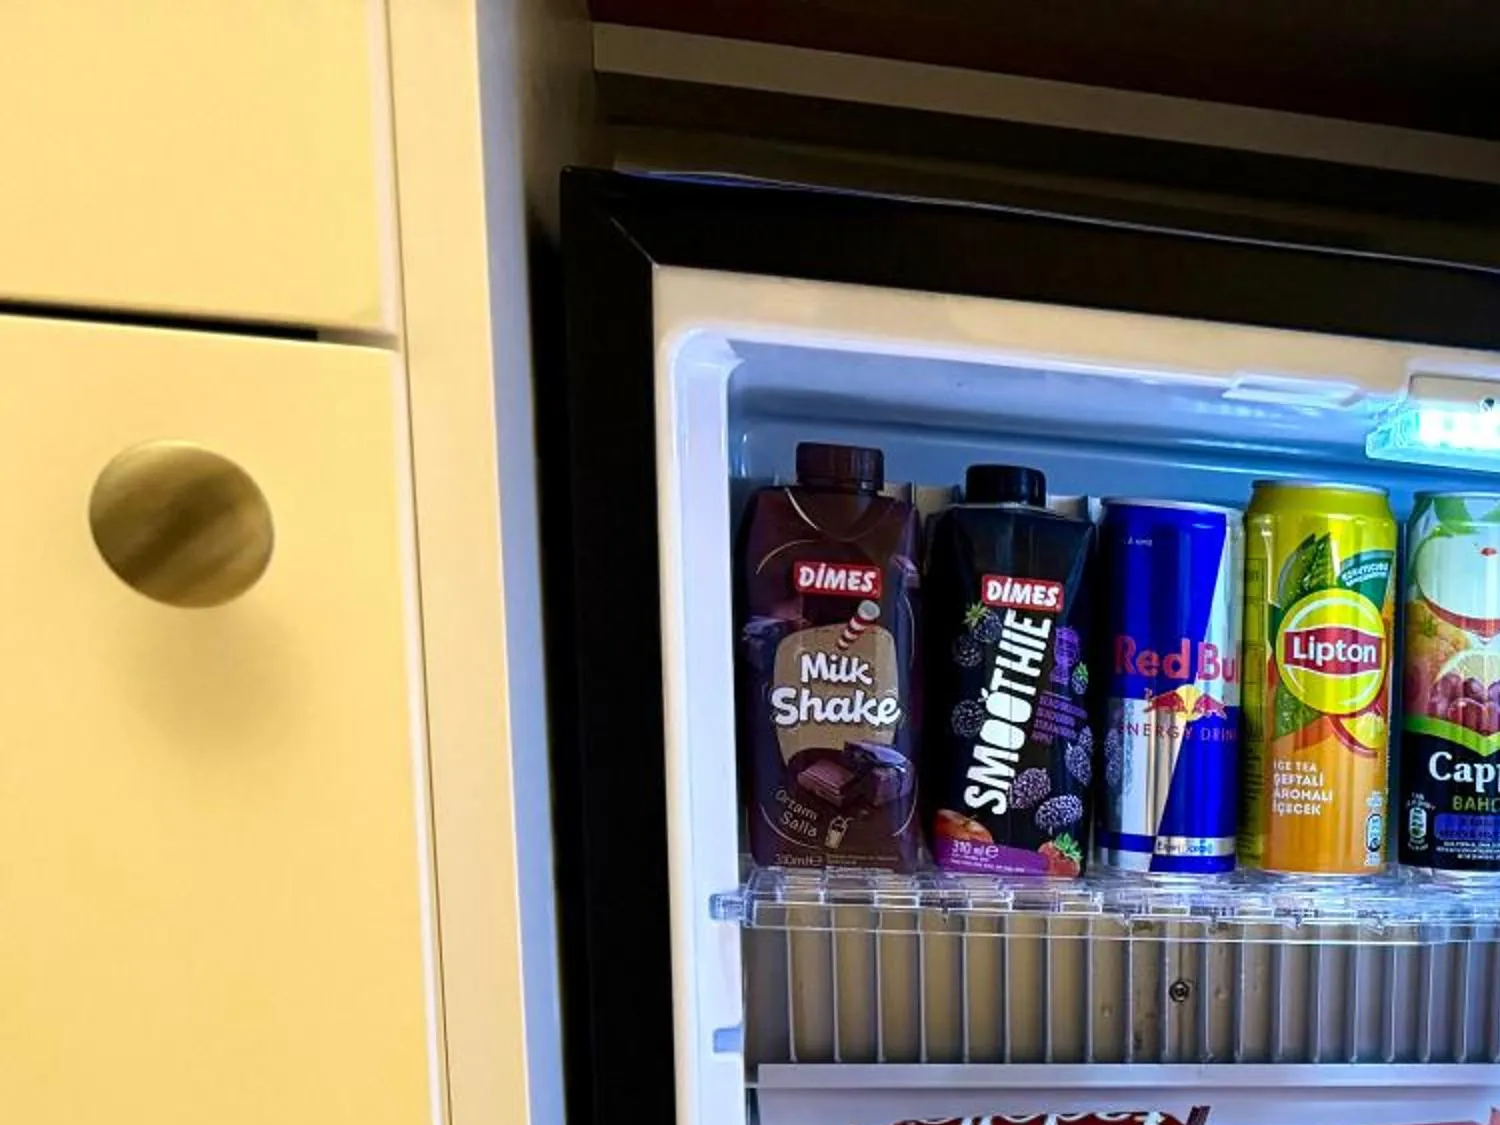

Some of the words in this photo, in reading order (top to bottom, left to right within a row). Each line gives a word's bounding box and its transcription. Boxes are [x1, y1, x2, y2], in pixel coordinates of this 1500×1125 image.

[801, 651, 873, 685] Milk
[1114, 635, 1191, 679] Red
[1292, 635, 1377, 667] Lipton
[771, 686, 901, 727] Shake
[963, 608, 1052, 815] SMOOTHIE
